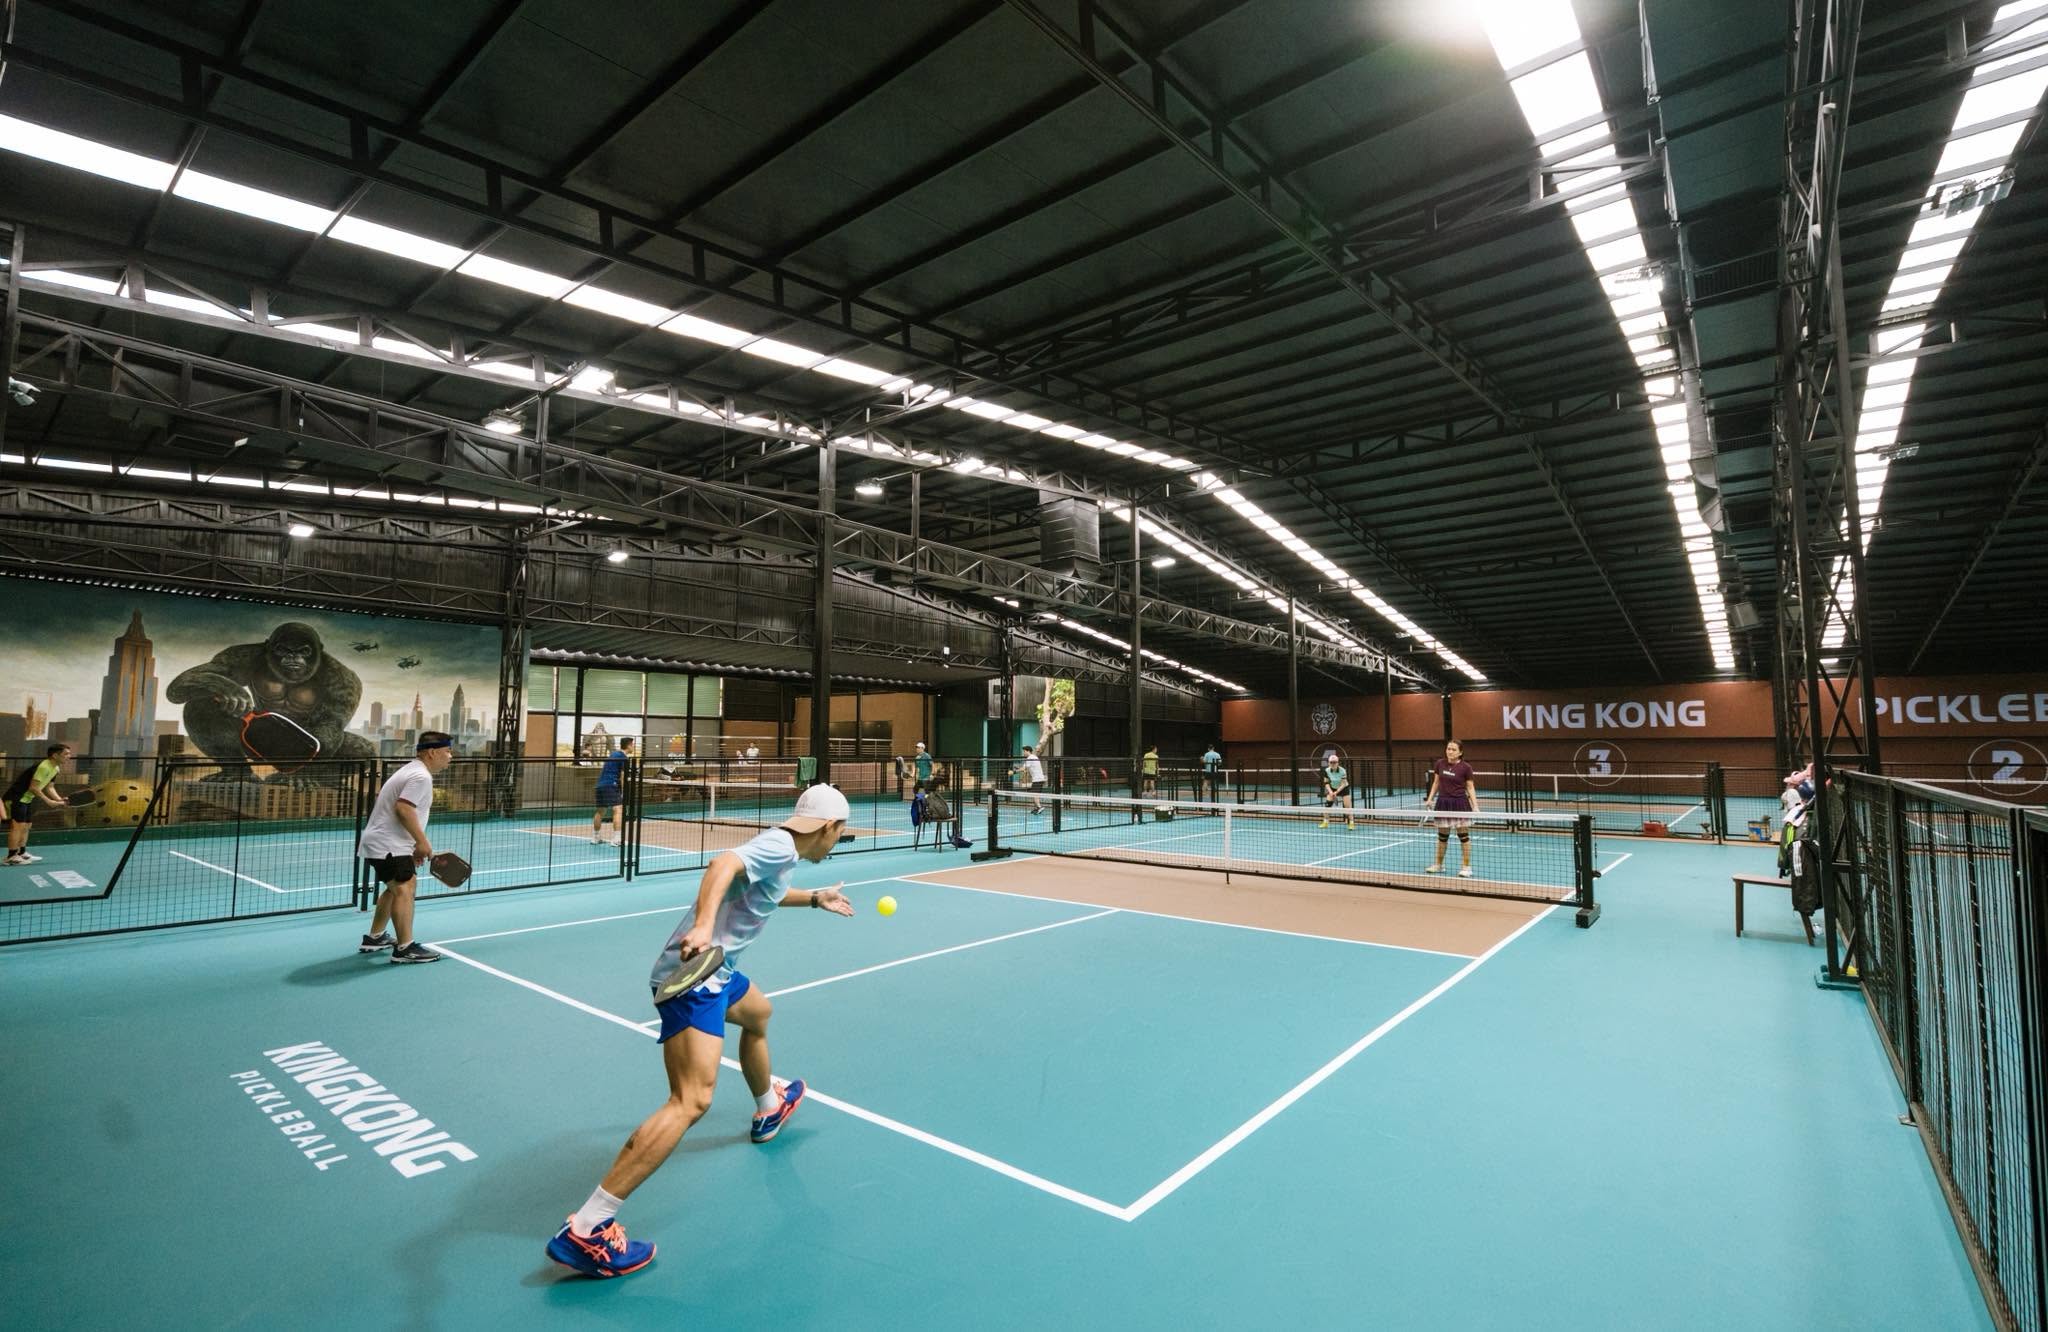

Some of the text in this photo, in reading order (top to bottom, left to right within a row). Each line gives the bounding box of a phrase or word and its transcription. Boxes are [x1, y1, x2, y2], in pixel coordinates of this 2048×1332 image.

[1502, 704, 1586, 730] KING
[1595, 700, 1706, 729] KONG
[1588, 749, 1612, 777] 3
[1991, 750, 2026, 784] 2
[229, 1069, 349, 1171] PICKLEBALL
[263, 1040, 479, 1179] KINGKONG
